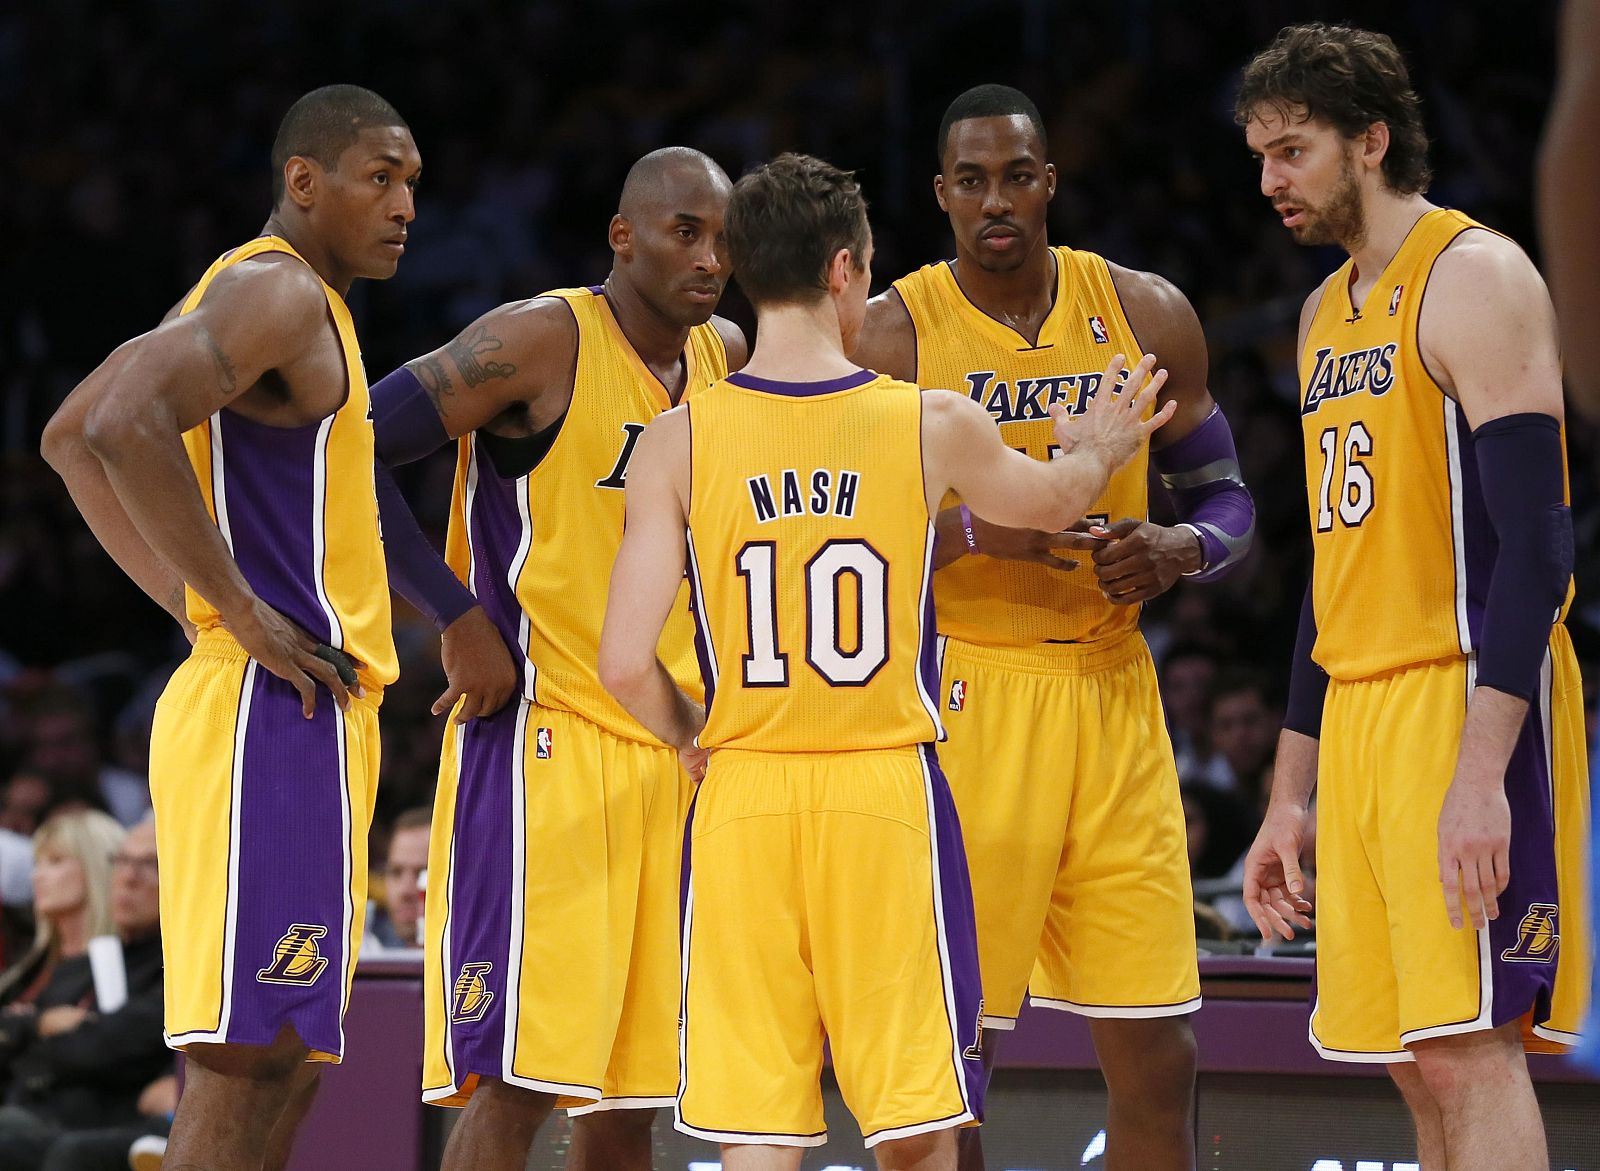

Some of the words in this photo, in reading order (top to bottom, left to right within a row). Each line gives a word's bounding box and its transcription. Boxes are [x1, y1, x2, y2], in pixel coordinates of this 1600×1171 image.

[1301, 342, 1398, 416] LAKERS
[746, 468, 861, 524] NASH
[1317, 420, 1375, 533] 16
[735, 538, 889, 688] 10
